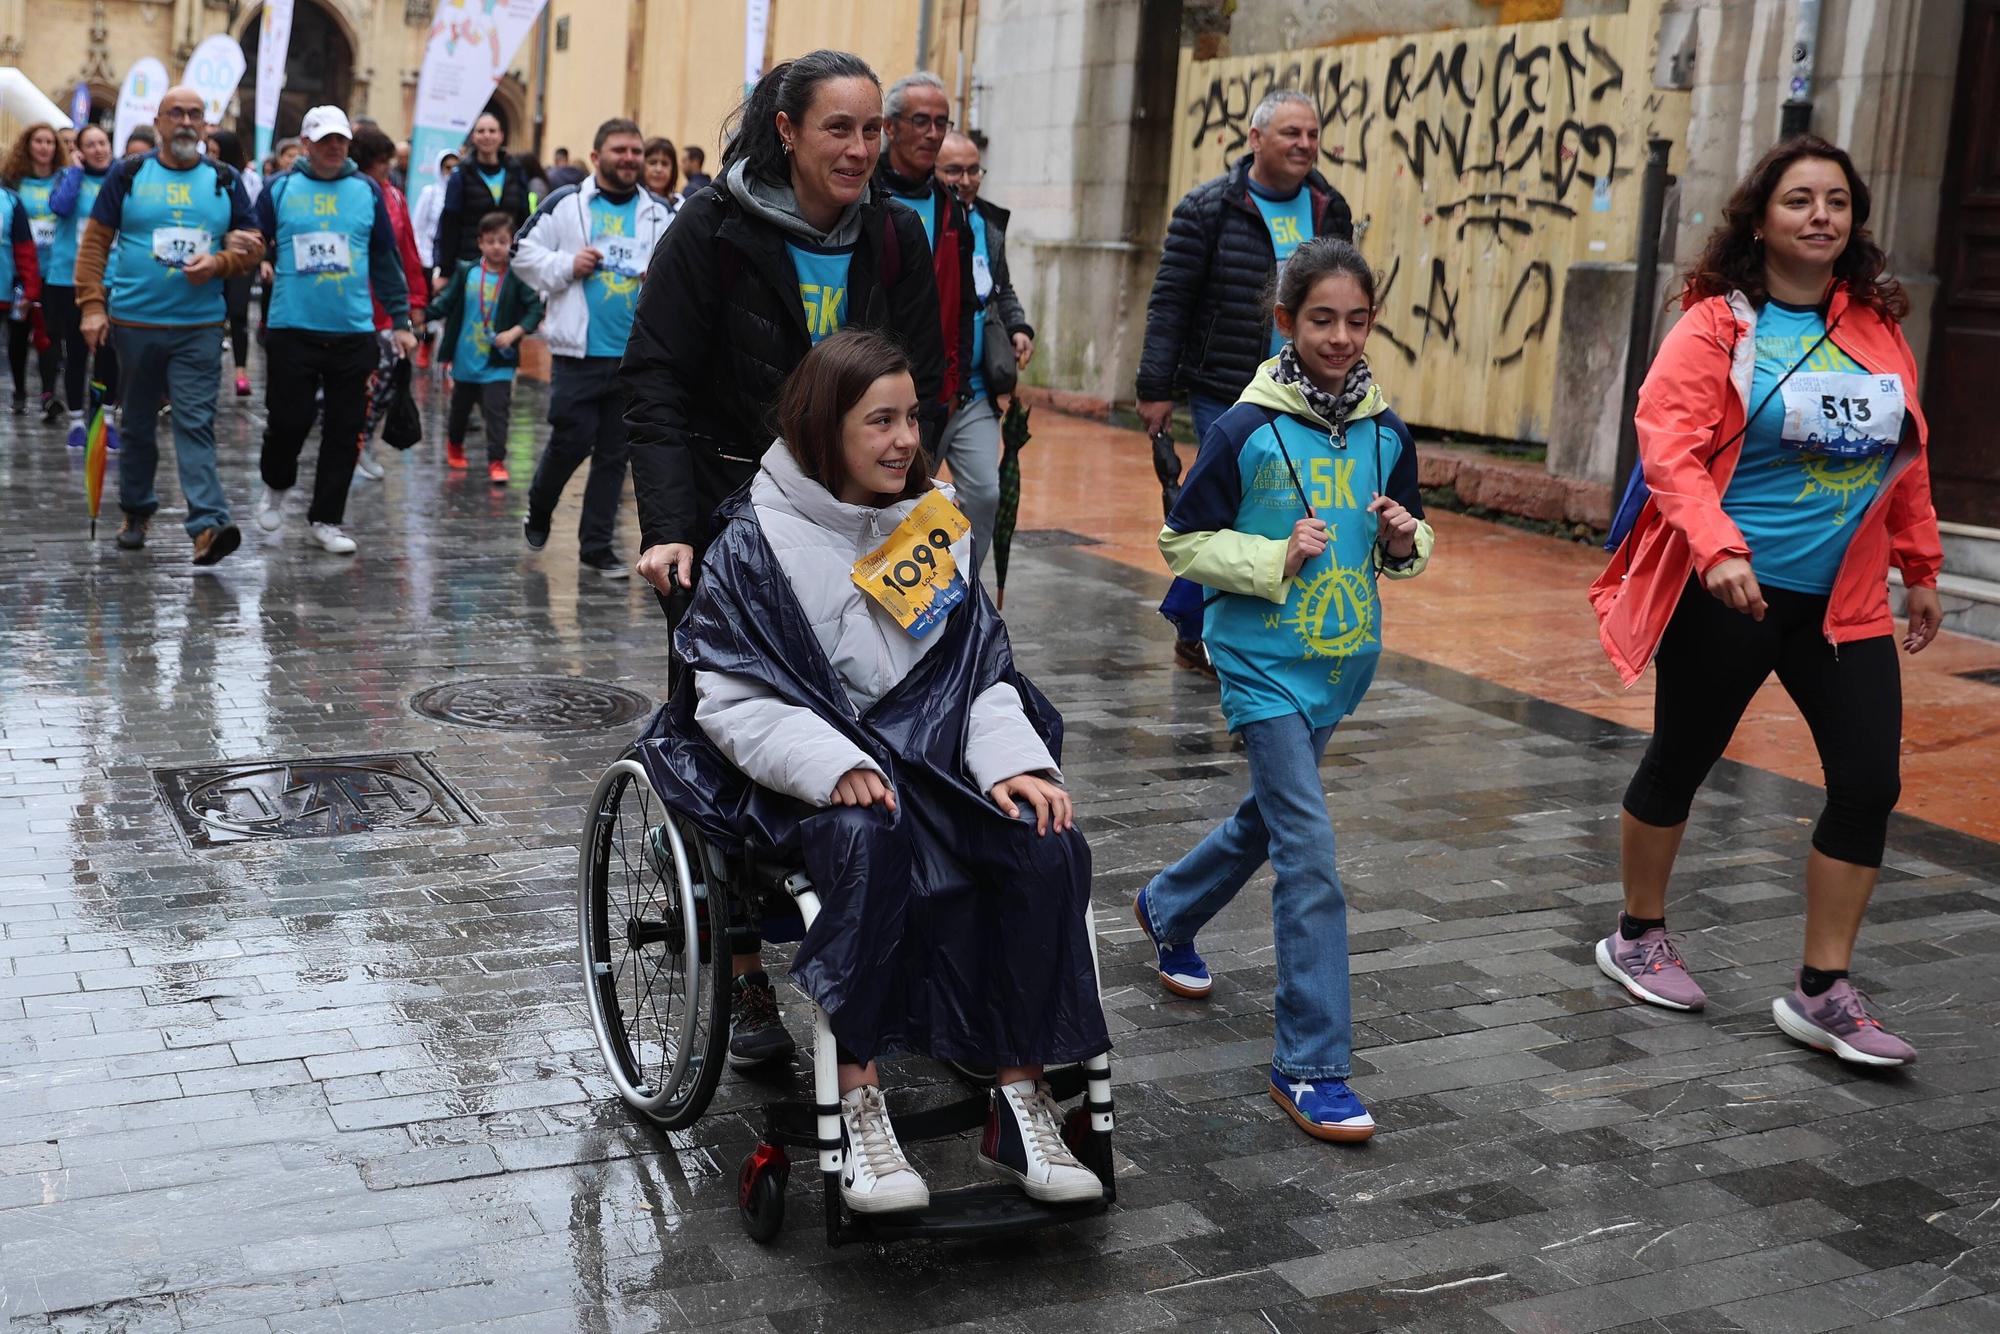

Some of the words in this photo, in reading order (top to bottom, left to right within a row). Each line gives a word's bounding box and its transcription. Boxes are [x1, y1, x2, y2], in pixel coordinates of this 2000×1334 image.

[166, 183, 192, 205] 5K
[313, 192, 337, 216] 5K
[604, 213, 625, 236] 5K
[1271, 216, 1303, 244] 5K
[173, 239, 196, 253] 172
[609, 245, 632, 259] 515
[799, 284, 844, 335] 5K
[1802, 335, 1856, 371] 5K
[1880, 379, 1897, 393] 5K
[1821, 395, 1871, 422] 513
[1310, 457, 1357, 509] 5K
[882, 528, 952, 597] 1099
[921, 571, 939, 587] LOLA
[1261, 612, 1281, 629] W
[1327, 670, 1343, 685] S
